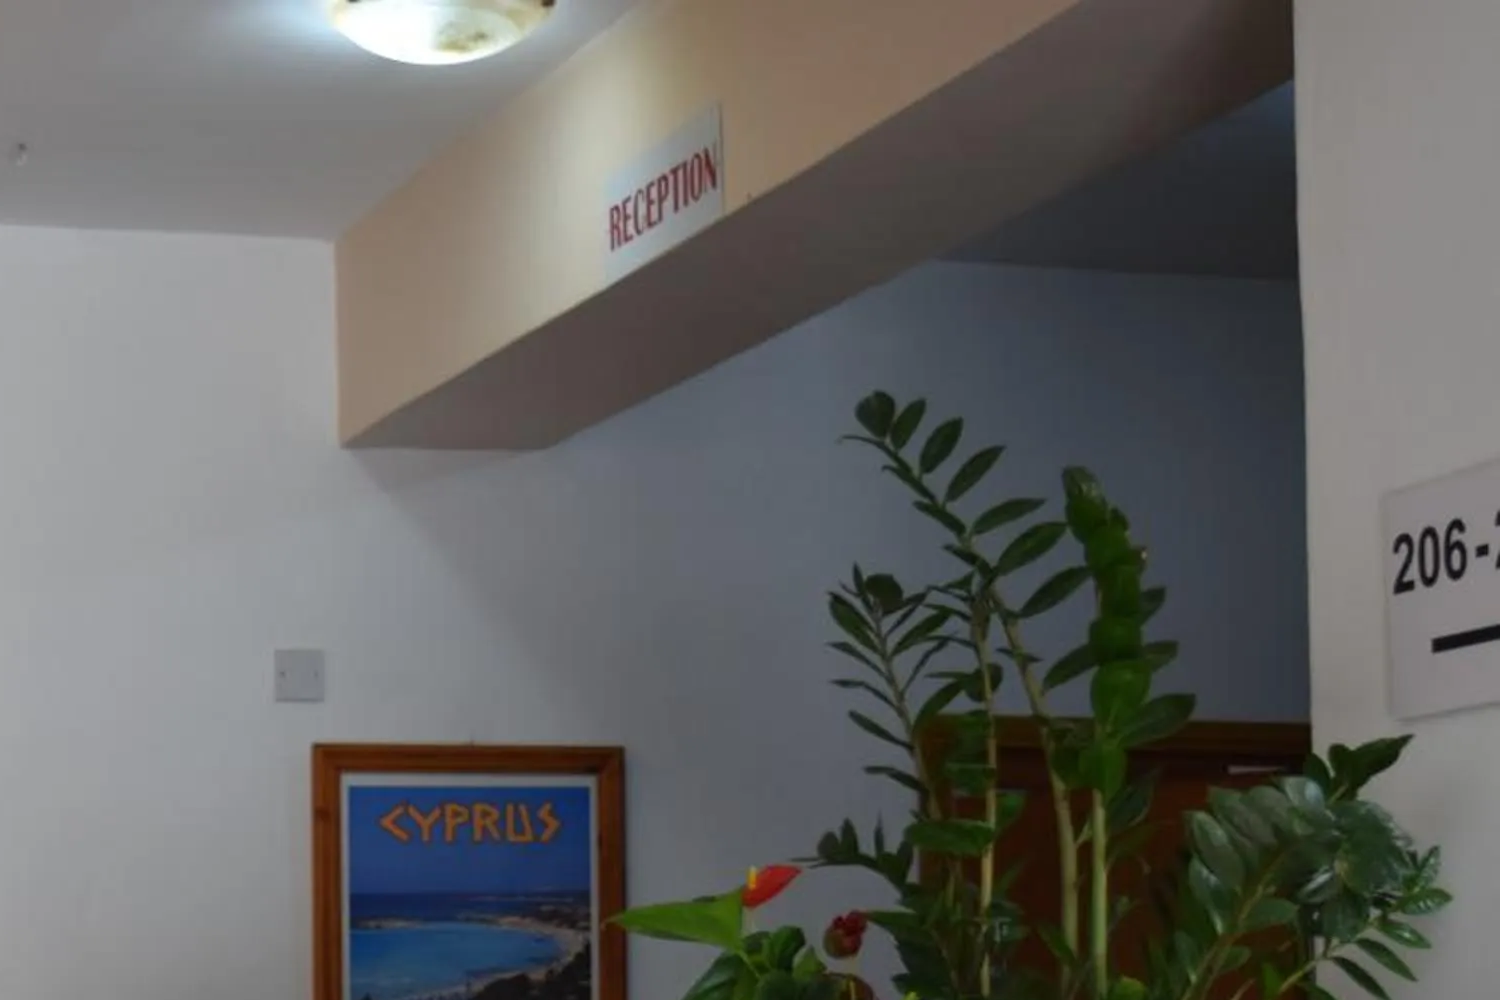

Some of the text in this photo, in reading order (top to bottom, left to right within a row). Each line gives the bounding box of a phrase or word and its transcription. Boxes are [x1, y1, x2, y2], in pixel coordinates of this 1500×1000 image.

[608, 140, 718, 252] RECEPTION
[1393, 510, 1500, 595] 206-
[379, 800, 562, 845] CYPRUS
